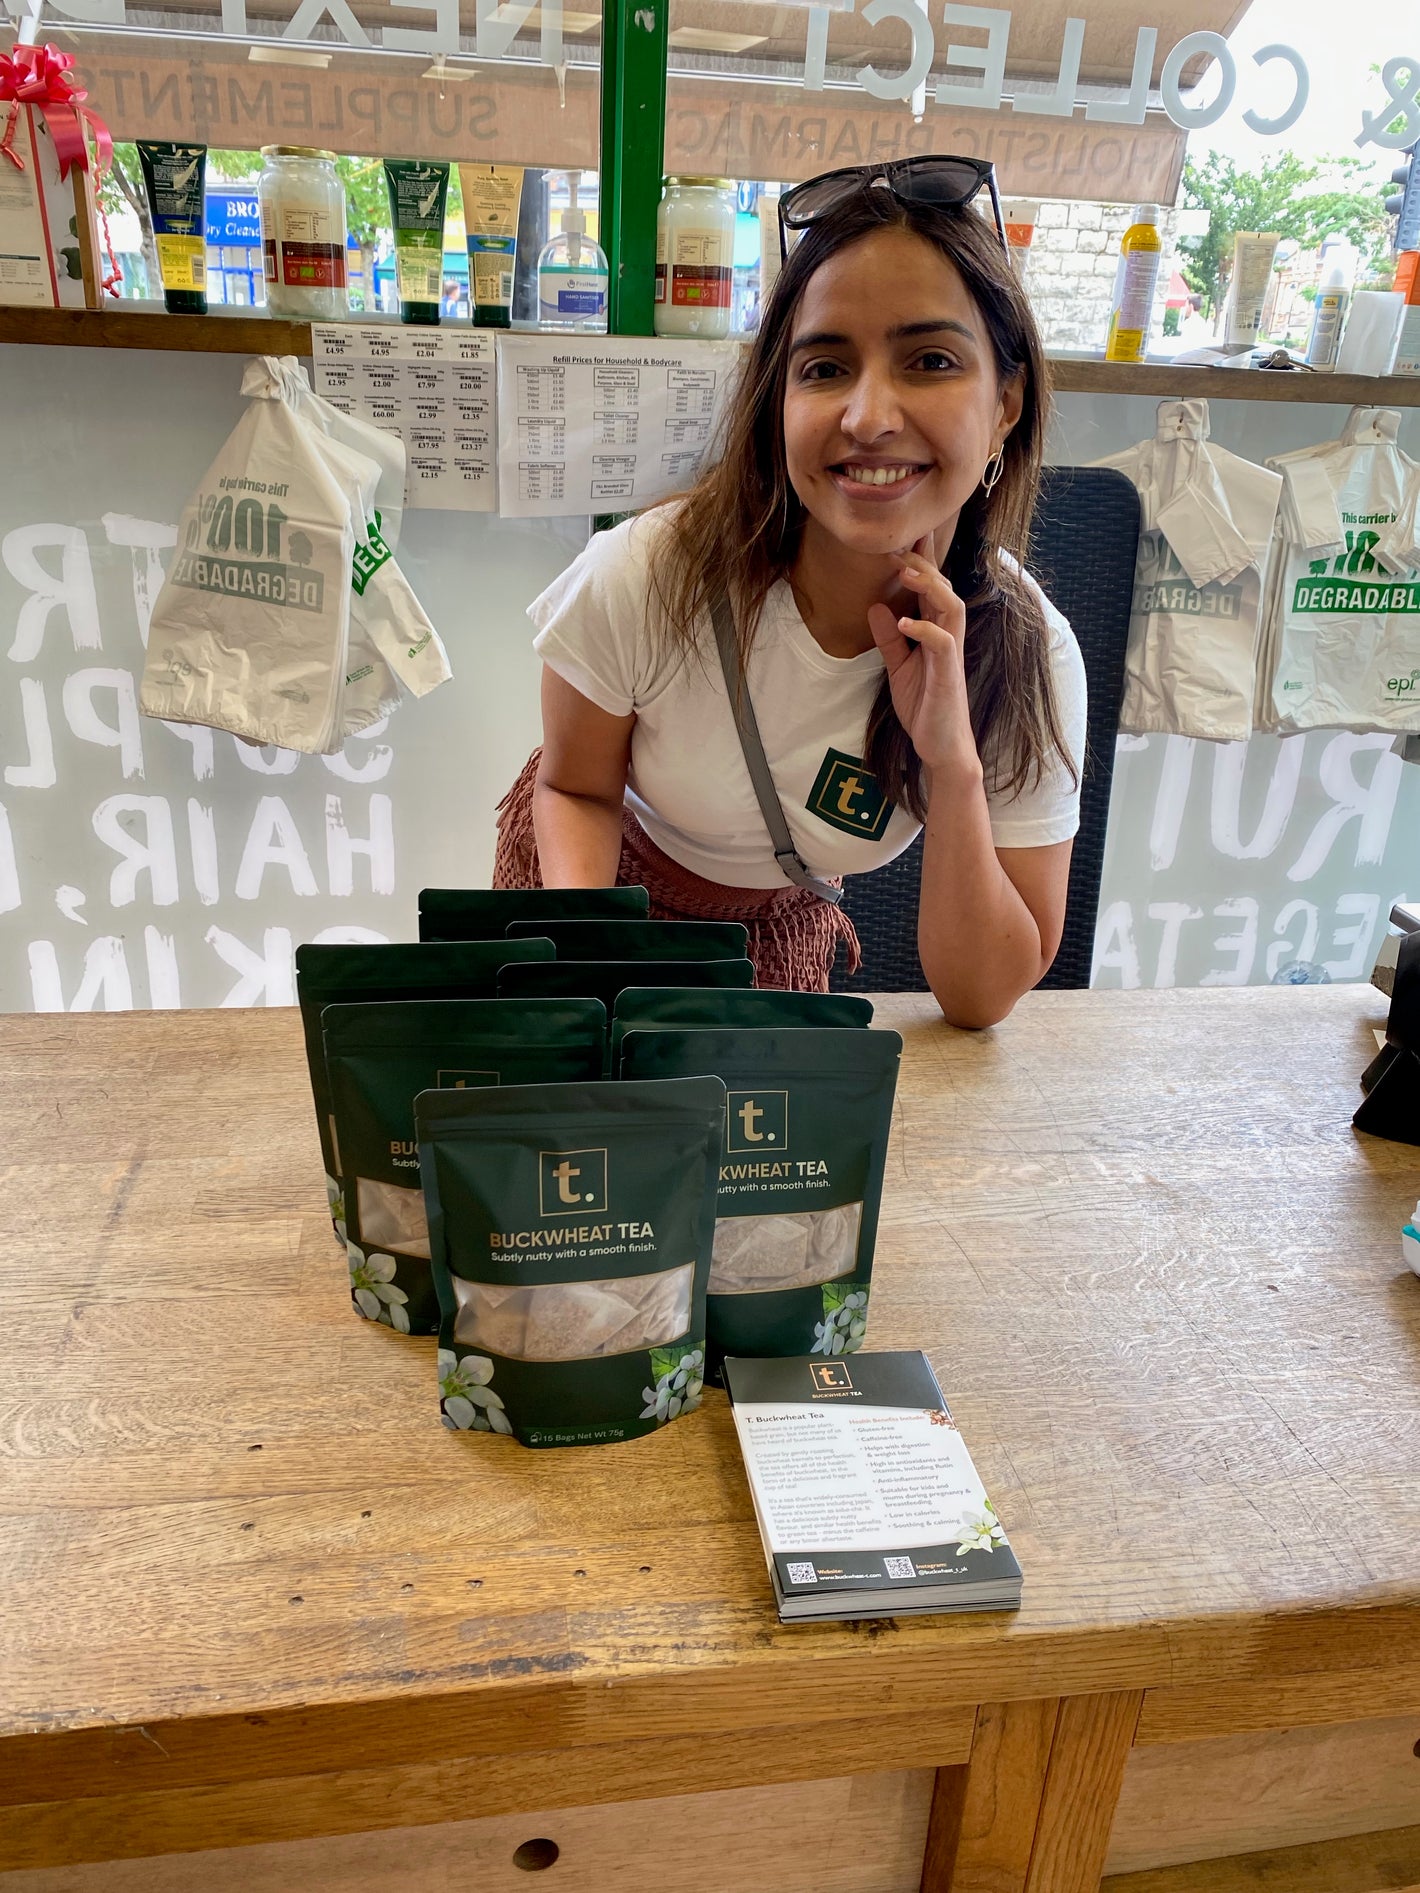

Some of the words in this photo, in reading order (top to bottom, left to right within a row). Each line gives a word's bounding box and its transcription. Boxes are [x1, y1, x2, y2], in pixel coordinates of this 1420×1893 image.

[606, 357, 641, 365] Household
[1342, 512, 1357, 524] This
[1358, 512, 1390, 524] carrier
[1297, 586, 1420, 610] DEGRADABL
[796, 1160, 828, 1176] TEA
[740, 1183, 758, 1192] with
[770, 1181, 803, 1190] smooth
[805, 1179, 830, 1188] finish.
[490, 1224, 613, 1248] BUCKWHEAT
[618, 1222, 654, 1239] TEA
[491, 1252, 523, 1263] Subtly
[526, 1252, 552, 1262] nutty
[556, 1249, 577, 1259] with
[589, 1244, 626, 1256] smooth
[629, 1243, 657, 1252] finish.
[756, 1414, 806, 1423] Buckwheat
[609, 1429, 624, 1437] 75g
